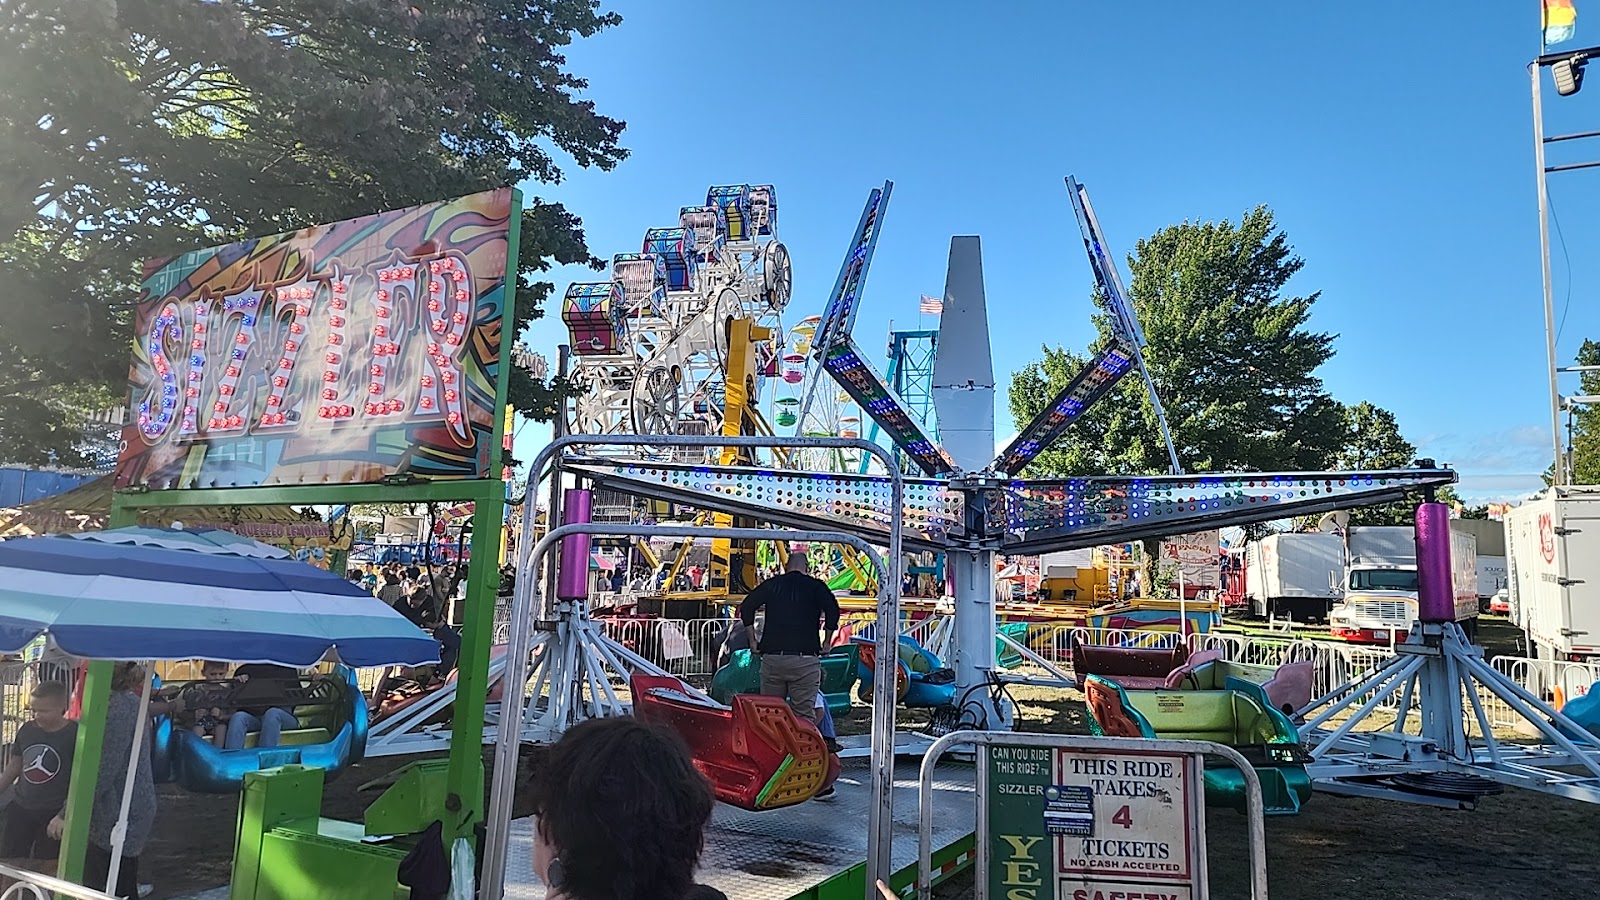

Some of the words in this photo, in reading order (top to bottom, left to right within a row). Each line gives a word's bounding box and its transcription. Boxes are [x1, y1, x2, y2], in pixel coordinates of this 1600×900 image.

[139, 250, 474, 447] SIZZLER
[992, 747, 1009, 759] CAN
[1011, 748, 1028, 760] YOU
[1031, 749, 1050, 761] RIDE
[996, 762, 1015, 774] THIS
[1017, 763, 1040, 775] RIDE?
[1070, 758, 1117, 776] THIS
[1122, 760, 1173, 778] RIDE
[998, 783, 1044, 795] SIZZLER
[1091, 779, 1157, 798] TAKES
[1112, 805, 1134, 829] 4
[1082, 839, 1170, 859] TICKETS
[1070, 859, 1086, 867] NO
[1089, 860, 1119, 869] CASH
[1122, 861, 1180, 872] ACCEPTED
